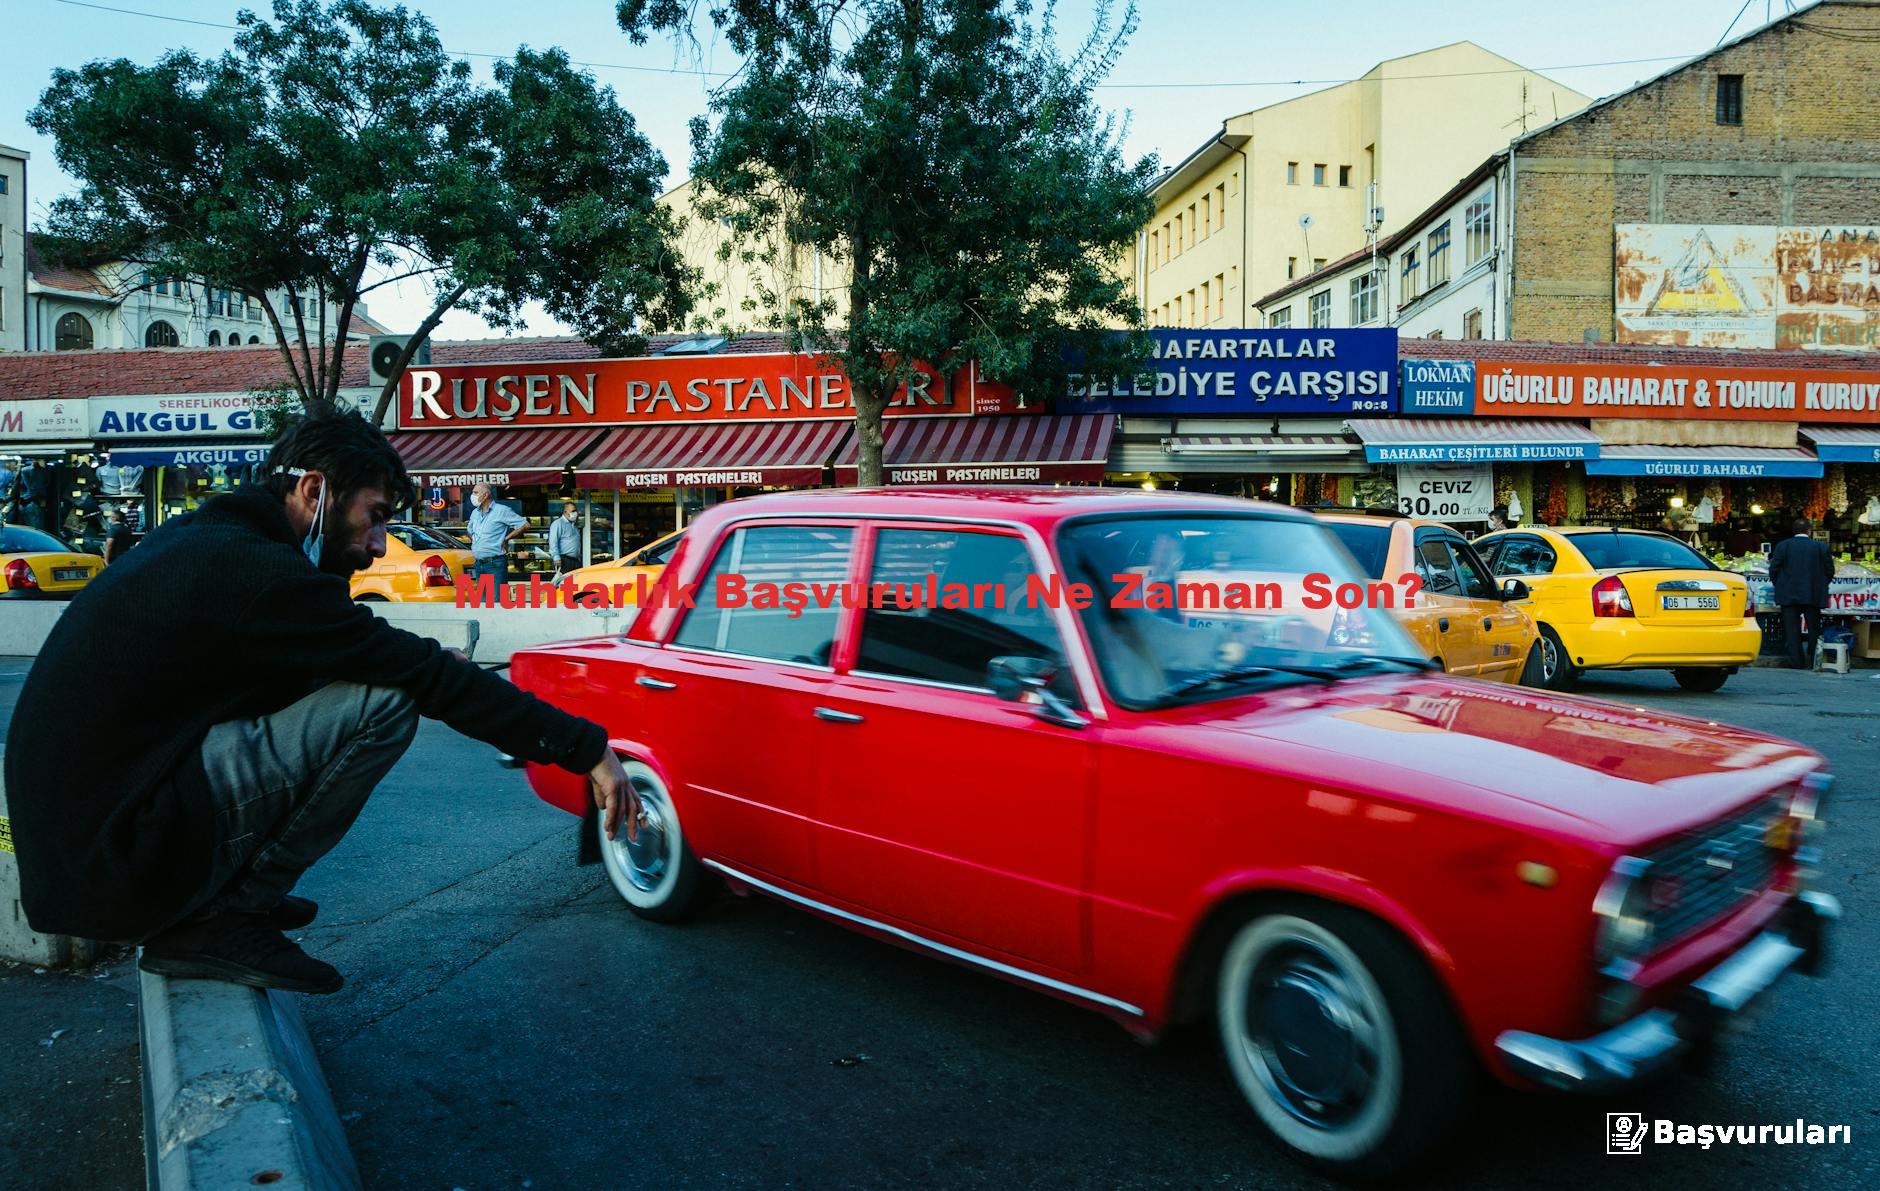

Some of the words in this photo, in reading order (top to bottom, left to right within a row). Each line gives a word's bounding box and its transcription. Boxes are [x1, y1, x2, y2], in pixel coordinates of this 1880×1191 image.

[1789, 285, 1880, 303] BASMA
[1122, 337, 1336, 359] NAFARTALAR
[1408, 366, 1471, 384] LOKMAN
[1250, 370, 1389, 402] ÇARŞISI
[1482, 367, 1574, 405] UĞURLU
[1583, 376, 1689, 407] BAHARAT
[1693, 378, 1711, 408] &
[1715, 379, 1796, 409] TOHUM
[409, 370, 597, 421] RUŞEN
[625, 371, 953, 414] PASTANERI
[1415, 387, 1464, 407] HEKİM
[1352, 400, 1389, 410] NO:8
[98, 410, 218, 432] AKGÜL
[173, 449, 239, 464] AKGÜL
[1379, 448, 1445, 460] BAHARAT
[1448, 444, 1518, 462] ÇEŞİTLERİ
[1521, 446, 1585, 458] BULUNUR
[891, 469, 938, 483] RUŞEN
[1645, 461, 1700, 475] UĞURLU
[1702, 464, 1765, 475] BAHARAT
[625, 473, 668, 487] RUŞEN
[1400, 496, 1460, 516] 30.00
[1668, 597, 1679, 608] 06
[1684, 597, 1689, 608] T
[1697, 597, 1718, 608] 5560
